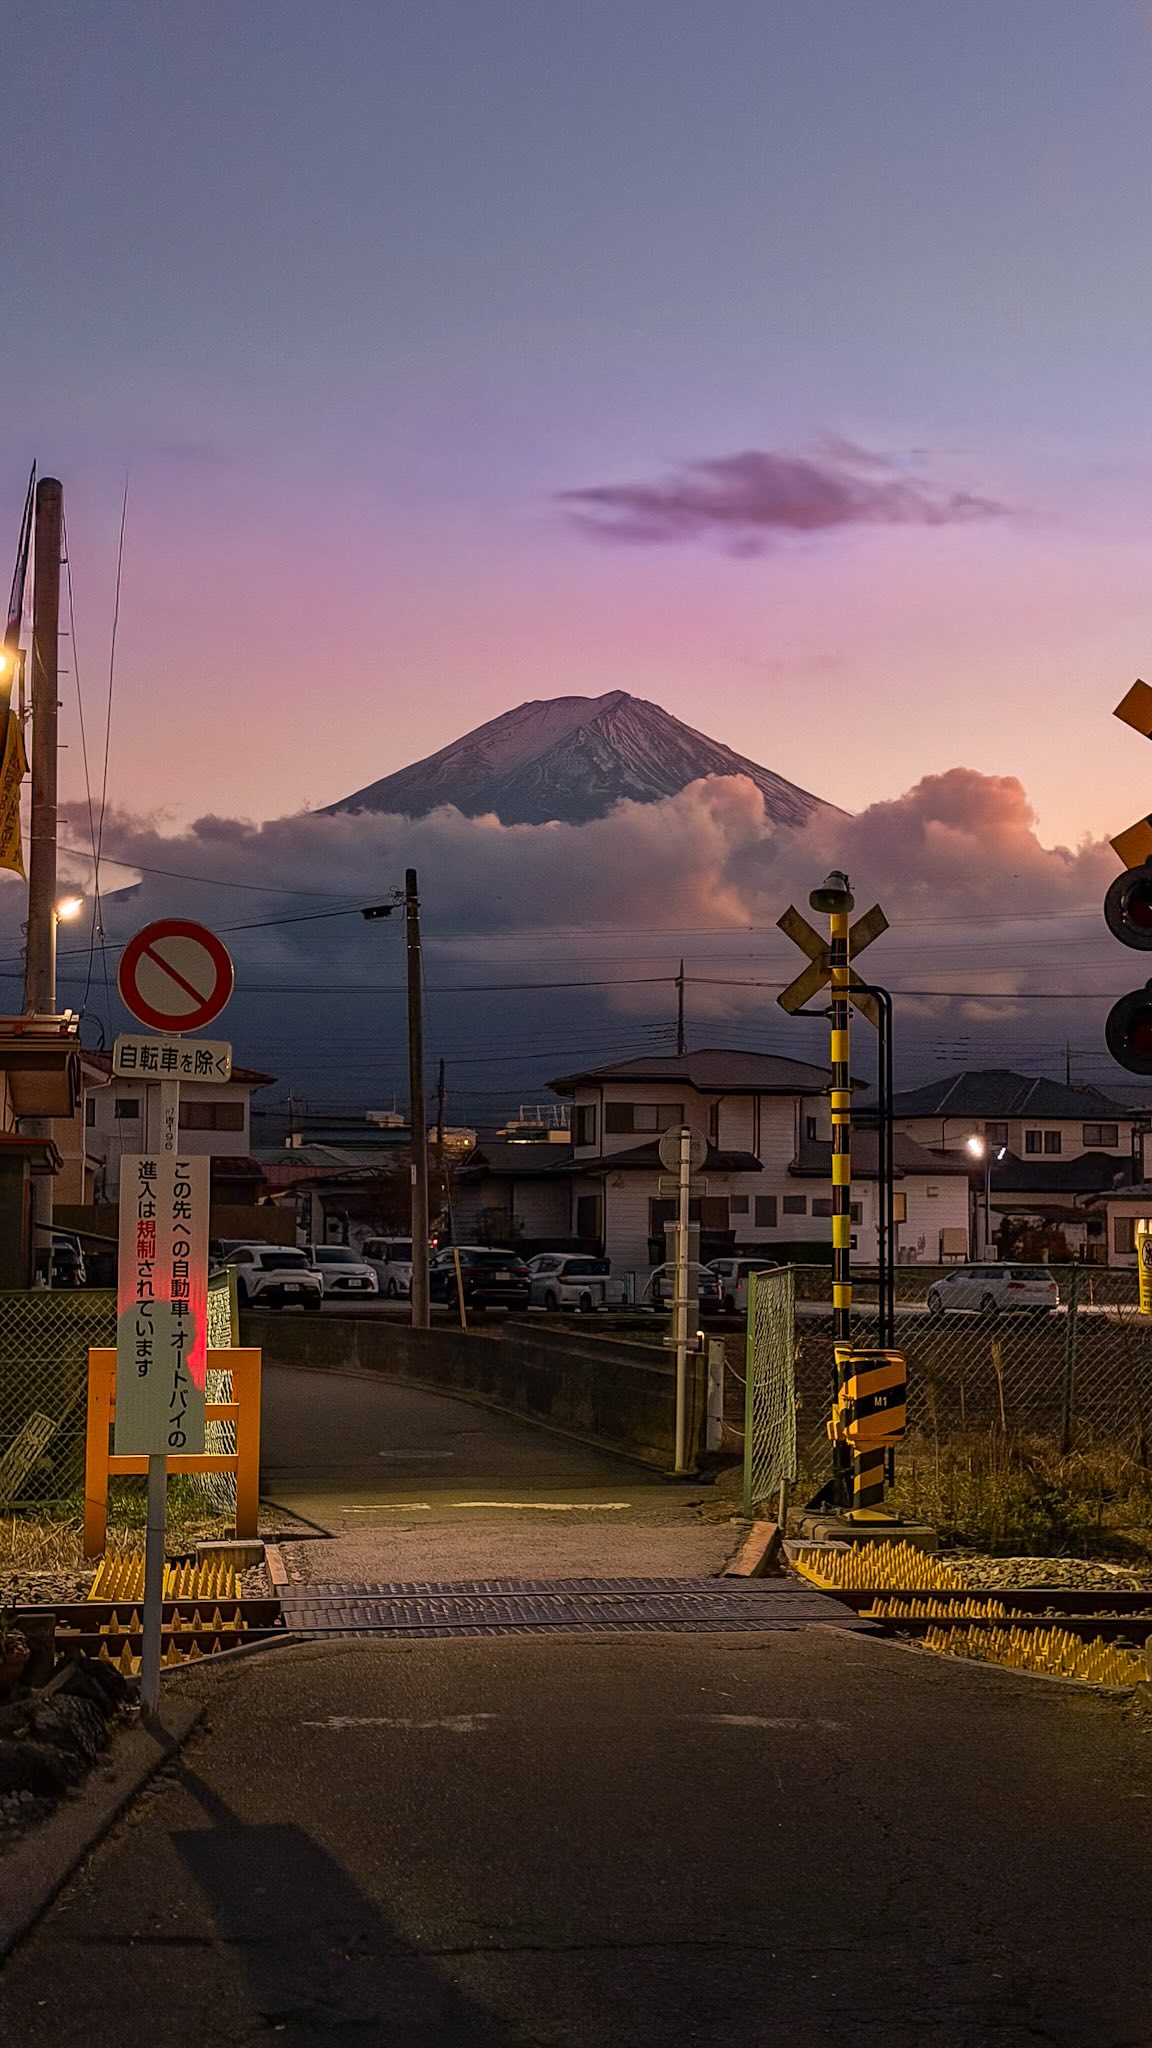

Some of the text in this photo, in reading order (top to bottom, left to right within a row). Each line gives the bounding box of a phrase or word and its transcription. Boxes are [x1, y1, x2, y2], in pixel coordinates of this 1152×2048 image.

[119, 1045, 227, 1076] 自転車を除く
[136, 1161, 157, 1377] 進入は規制されています
[168, 1161, 192, 1448] この先への自動車・オートバイの
[874, 1396, 888, 1407] M1
